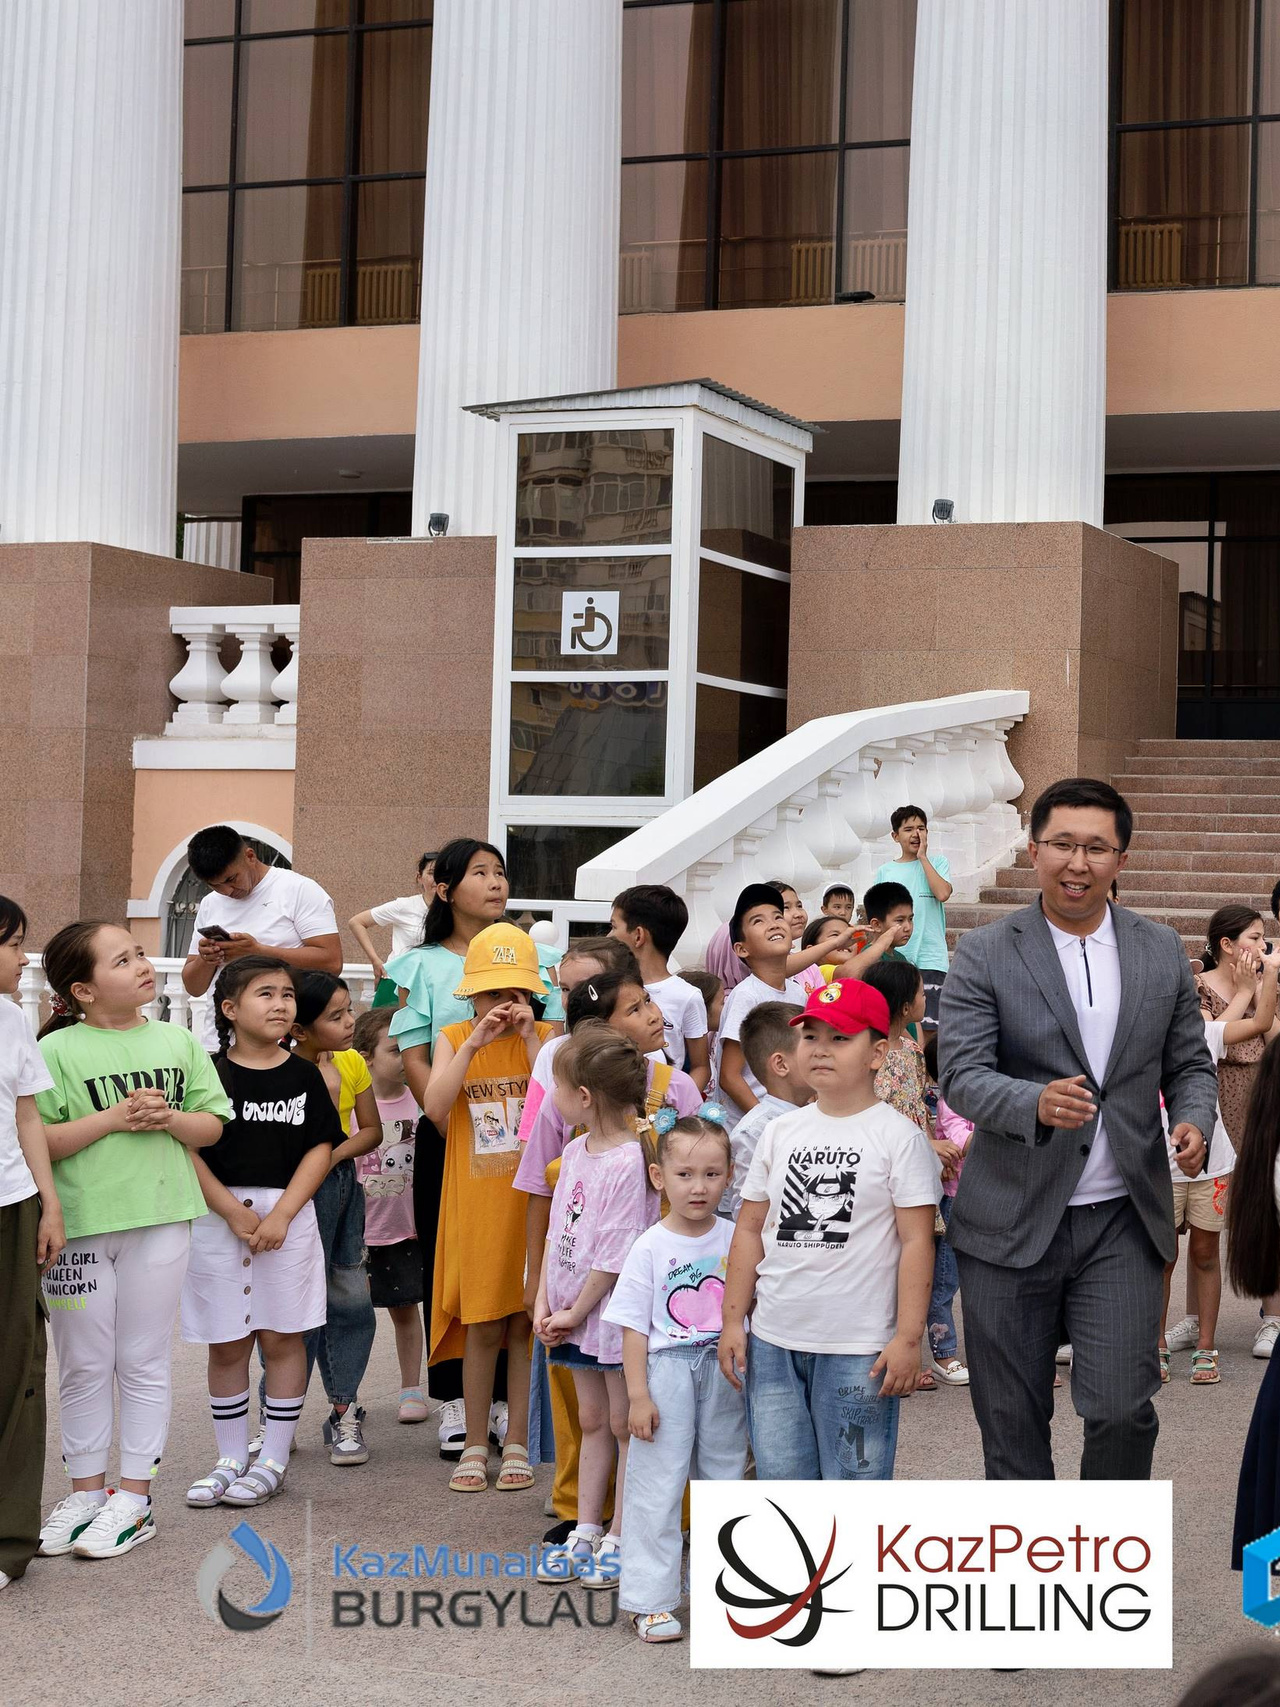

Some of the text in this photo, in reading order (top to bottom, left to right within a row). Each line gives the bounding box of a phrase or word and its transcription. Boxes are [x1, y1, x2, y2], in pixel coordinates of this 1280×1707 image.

[492, 946, 517, 965] ZARA
[464, 1083, 493, 1099] NEW
[242, 1091, 307, 1126] UNIQUE
[788, 1151, 861, 1168] NARUTO
[778, 1241, 802, 1249] NARUTO
[71, 1252, 99, 1266] GIRL
[668, 1262, 694, 1281] DREAM
[689, 1268, 703, 1284] BIG
[46, 1279, 98, 1296] UNICORN
[841, 1405, 862, 1421] SKIP
